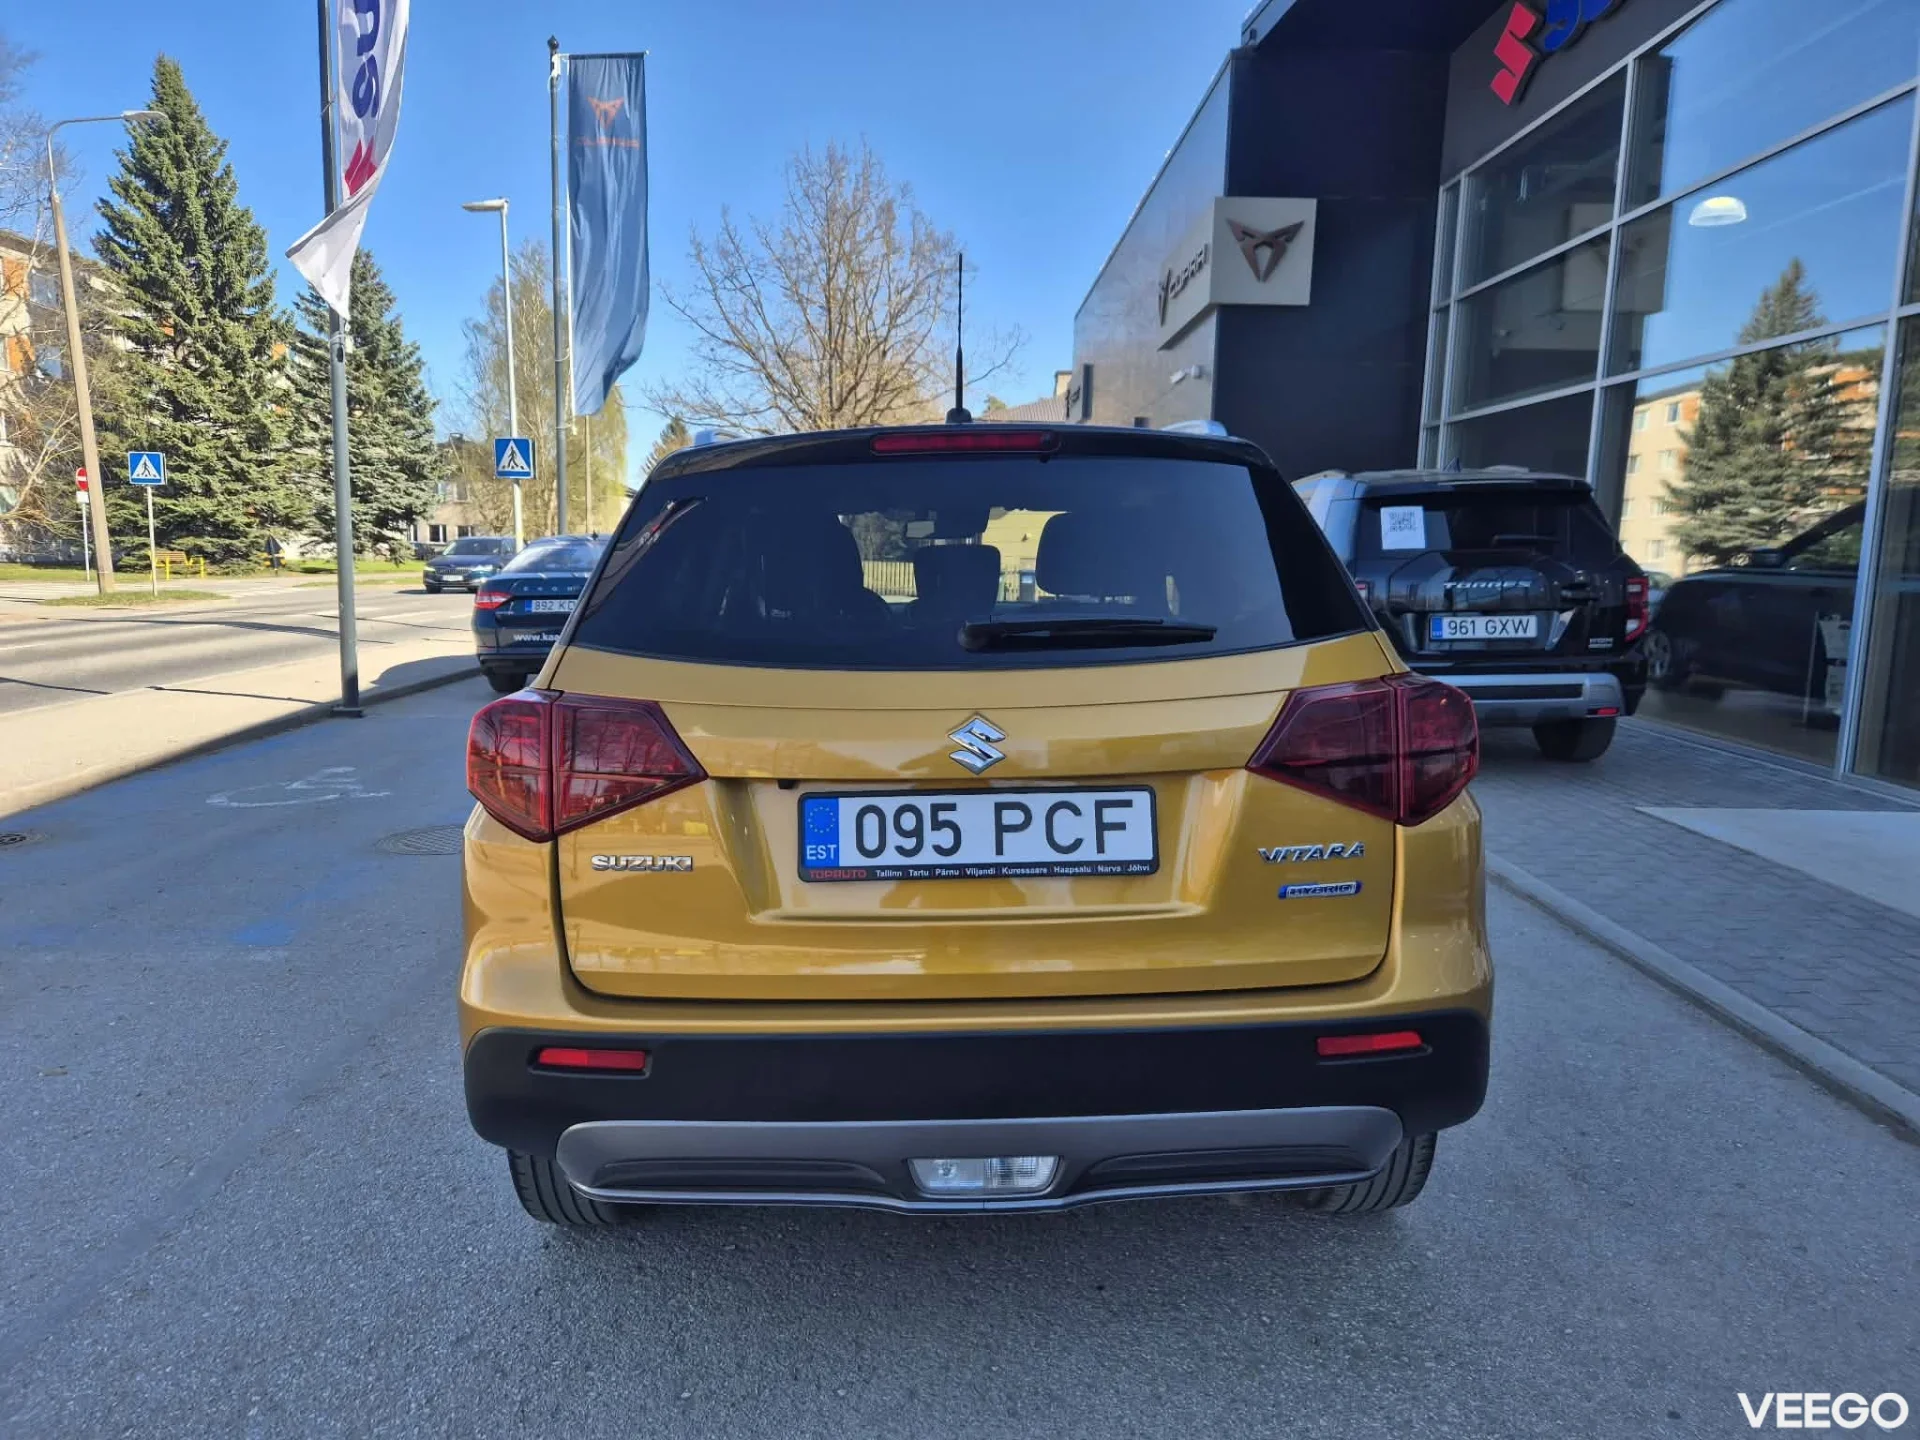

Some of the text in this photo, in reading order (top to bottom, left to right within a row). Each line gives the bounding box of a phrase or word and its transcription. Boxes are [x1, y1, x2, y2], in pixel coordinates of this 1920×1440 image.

[535, 600, 554, 611] 892
[1447, 618, 1531, 636] 961 GXW
[855, 798, 1134, 860] 095 PCF
[806, 844, 837, 861] EST
[1257, 841, 1365, 863] VITARA
[591, 855, 693, 872] SUZUKI
[875, 869, 902, 878] Tallinn
[908, 868, 930, 877] Tartu
[935, 867, 960, 876] Pärnu
[965, 866, 996, 877] Viljandi
[1001, 866, 1048, 876] Kuressaare
[1053, 865, 1092, 875] Haapsalu
[1097, 865, 1122, 873] Narva
